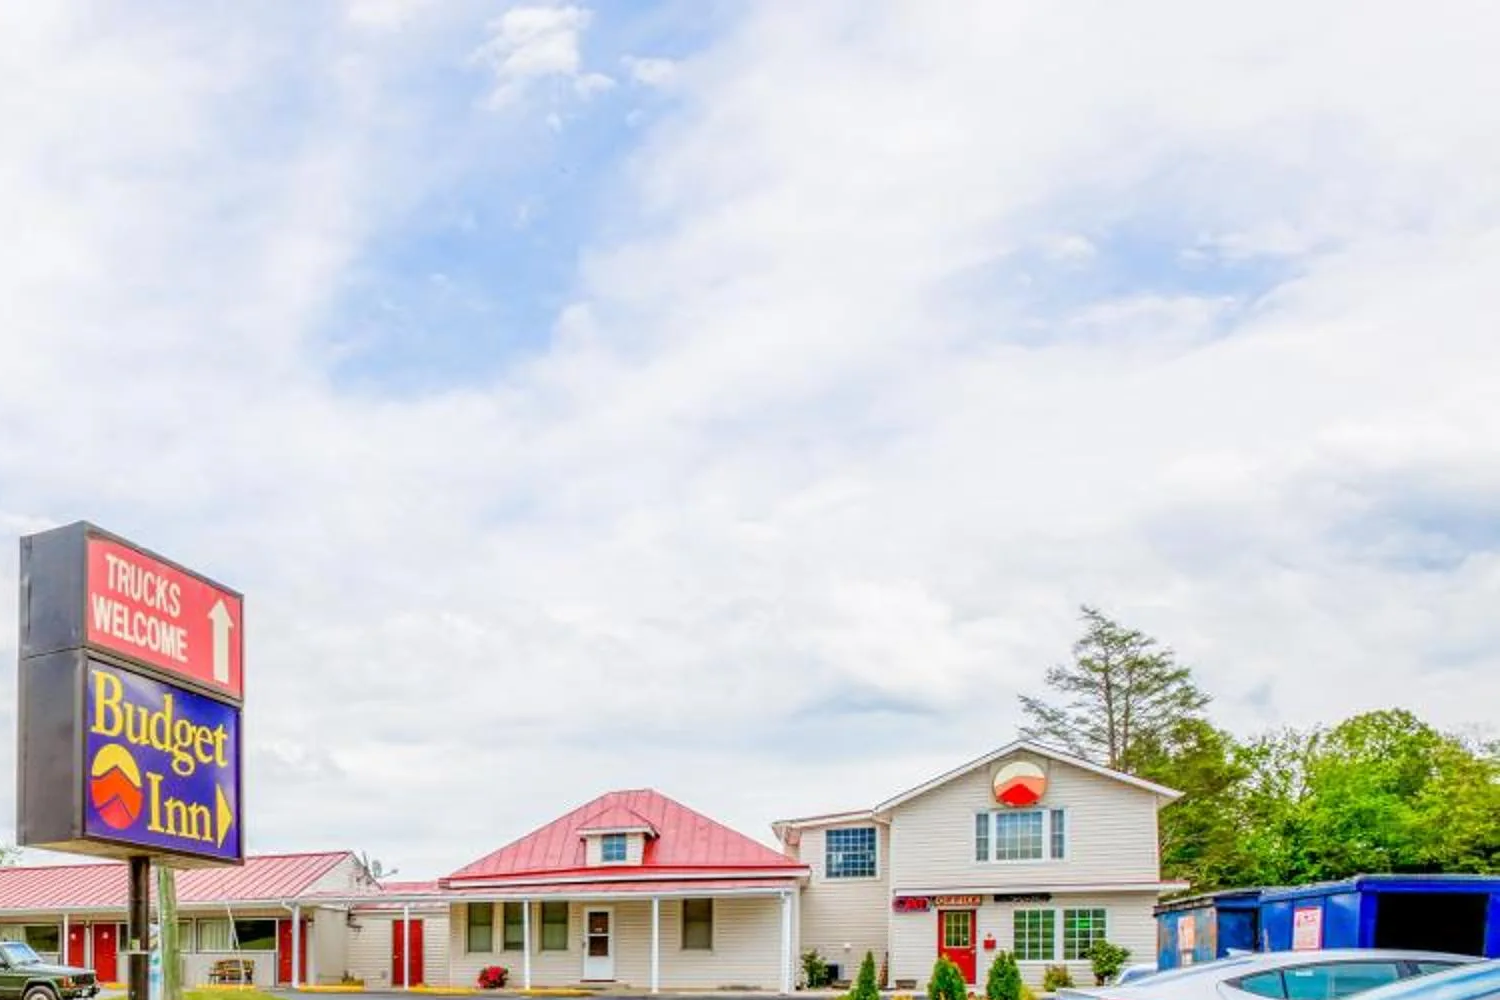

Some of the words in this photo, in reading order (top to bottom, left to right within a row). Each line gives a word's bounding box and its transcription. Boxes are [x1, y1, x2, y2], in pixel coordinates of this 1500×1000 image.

[106, 554, 181, 617] TRUCKS
[92, 594, 188, 662] WELCOME
[90, 669, 230, 777] Budget
[146, 771, 214, 843] Inn
